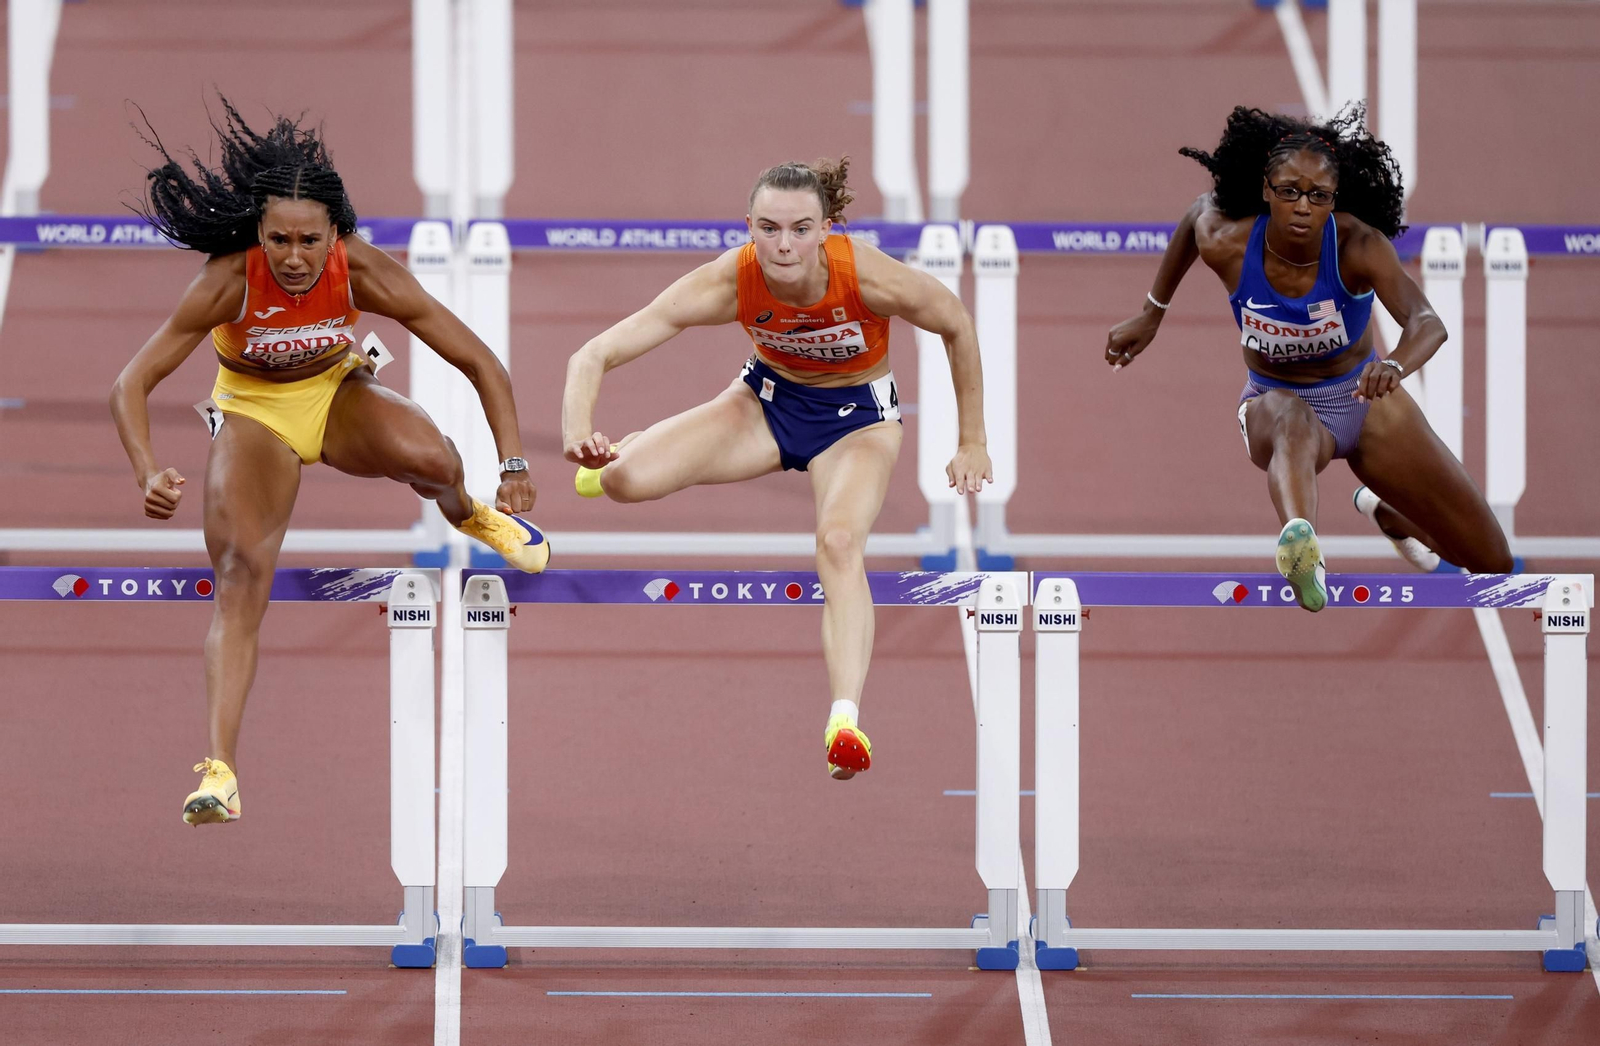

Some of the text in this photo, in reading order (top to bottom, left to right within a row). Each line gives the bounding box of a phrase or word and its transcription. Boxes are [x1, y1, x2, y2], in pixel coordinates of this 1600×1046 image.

[36, 224, 106, 243] WORLD
[546, 228, 616, 247] WORLD
[620, 228, 721, 247] ATHLETICS
[1052, 231, 1121, 250] WORLD
[1244, 314, 1342, 338] HONDA
[250, 333, 354, 354] HONDA
[754, 327, 859, 344] HONDA
[1246, 334, 1344, 356] CHAPMAN
[811, 583, 825, 600] 2
[393, 609, 430, 621] NISHI
[467, 610, 505, 622] NISHI
[980, 613, 1018, 625] NISHI
[1039, 614, 1076, 625] NISHI
[1548, 615, 1585, 627] NISHI
